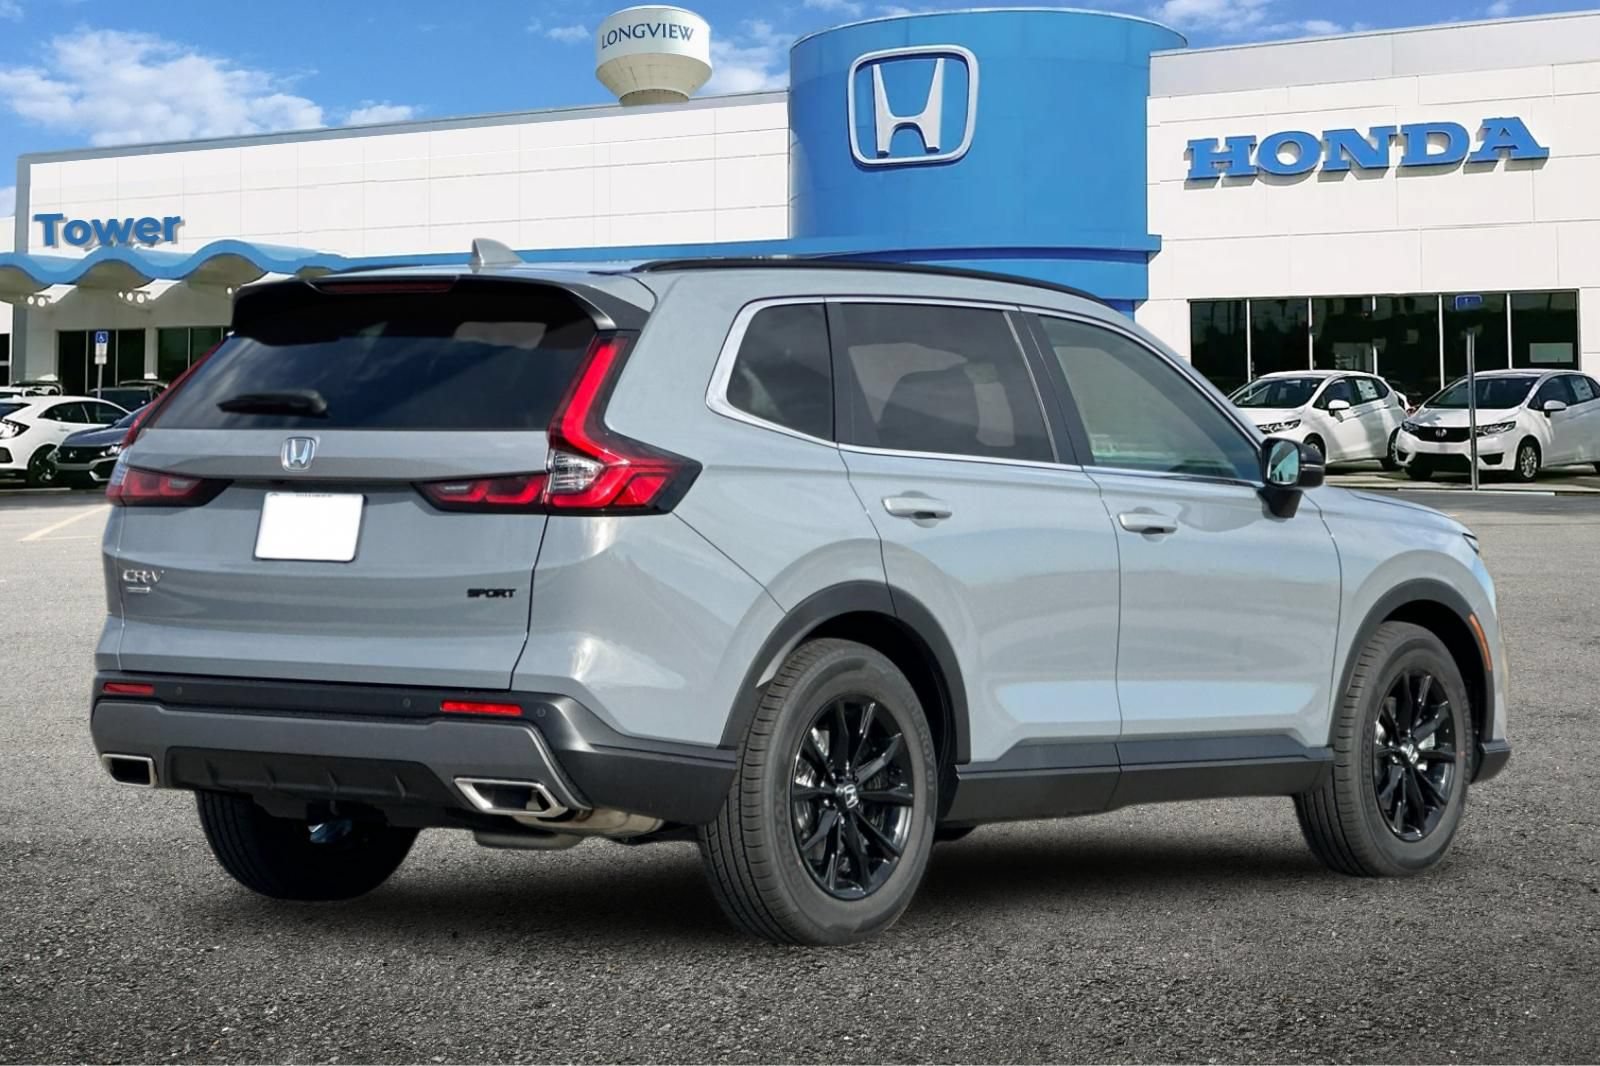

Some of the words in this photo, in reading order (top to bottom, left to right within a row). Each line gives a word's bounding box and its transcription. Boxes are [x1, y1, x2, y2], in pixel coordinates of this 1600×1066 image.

[601, 23, 694, 49] LONGVIEW
[1186, 116, 1550, 183] HONDA
[33, 213, 183, 248] Tower
[467, 588, 517, 598] SPORT
